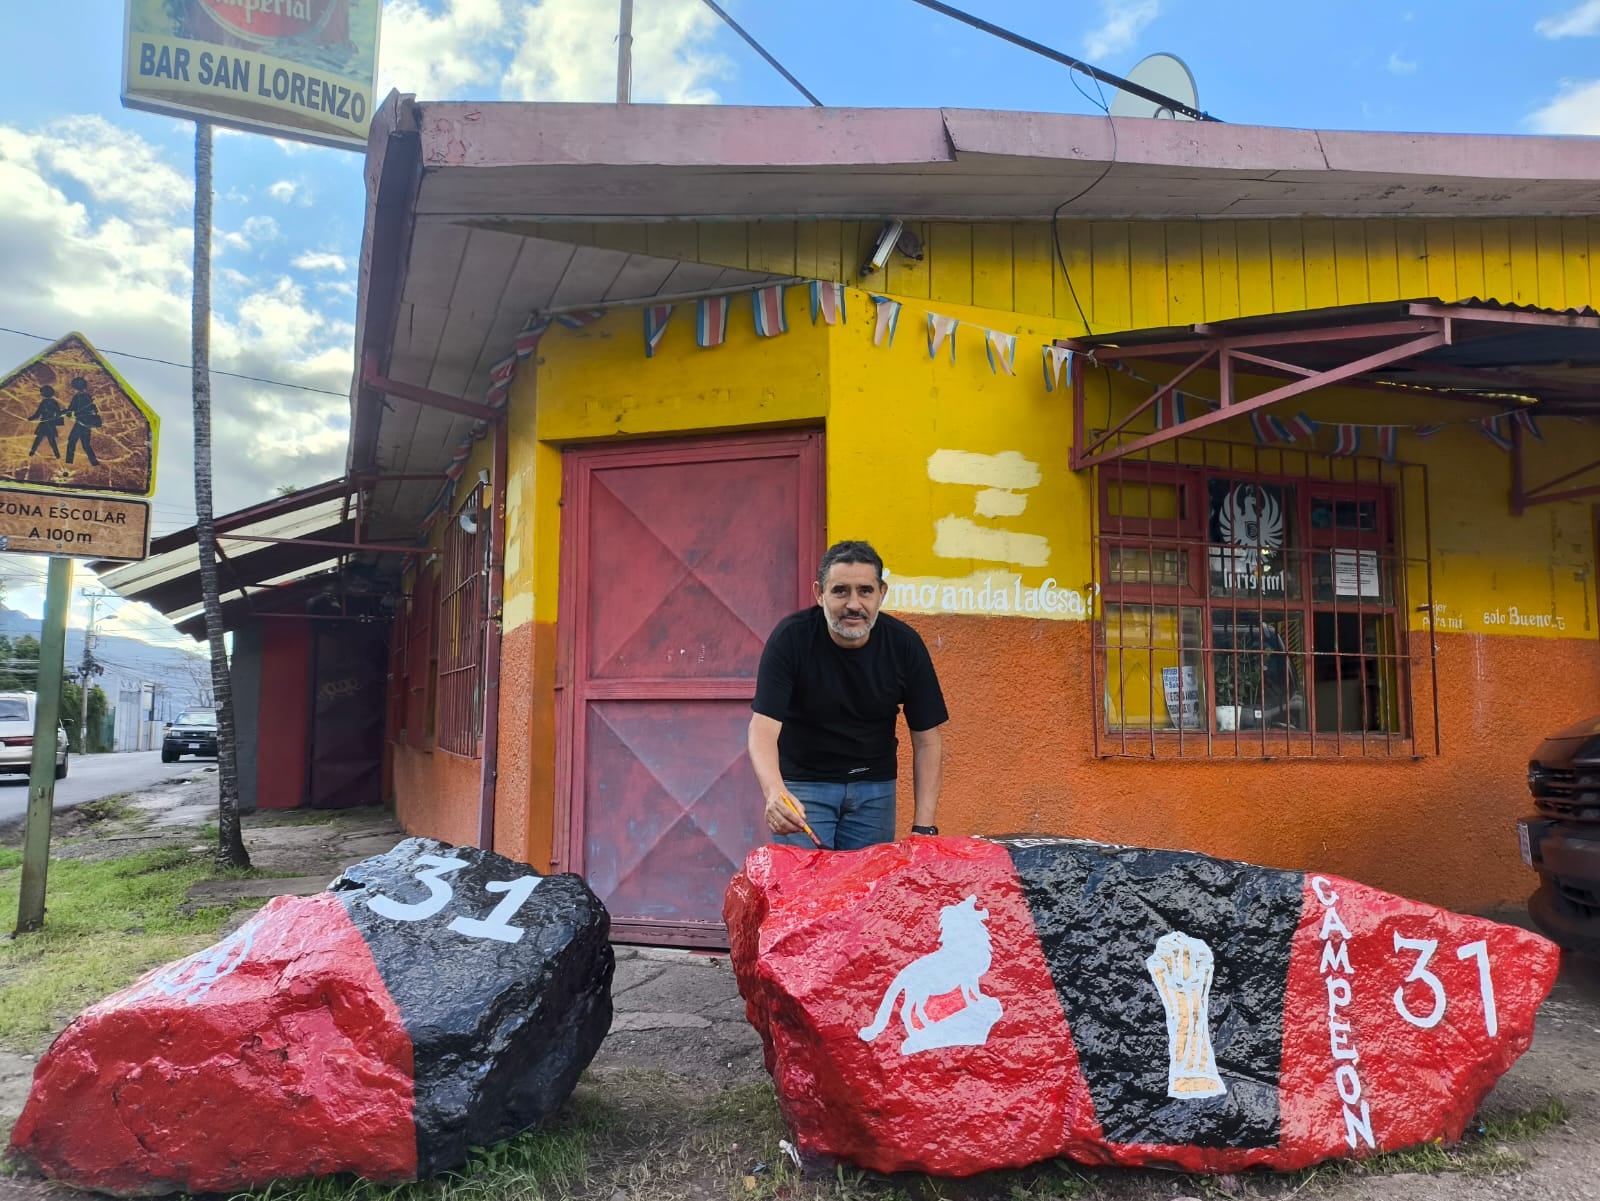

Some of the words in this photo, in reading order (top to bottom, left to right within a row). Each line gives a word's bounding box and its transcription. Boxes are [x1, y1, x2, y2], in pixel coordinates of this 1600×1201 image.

[140, 42, 190, 82] BAR
[198, 51, 250, 93] SAN
[258, 63, 365, 123] LORENZO
[28, 527, 40, 538] A
[49, 506, 126, 524] ESCOLAR
[1483, 608, 1506, 625] solo
[367, 854, 543, 943] 31
[1393, 930, 1498, 1038] 31
